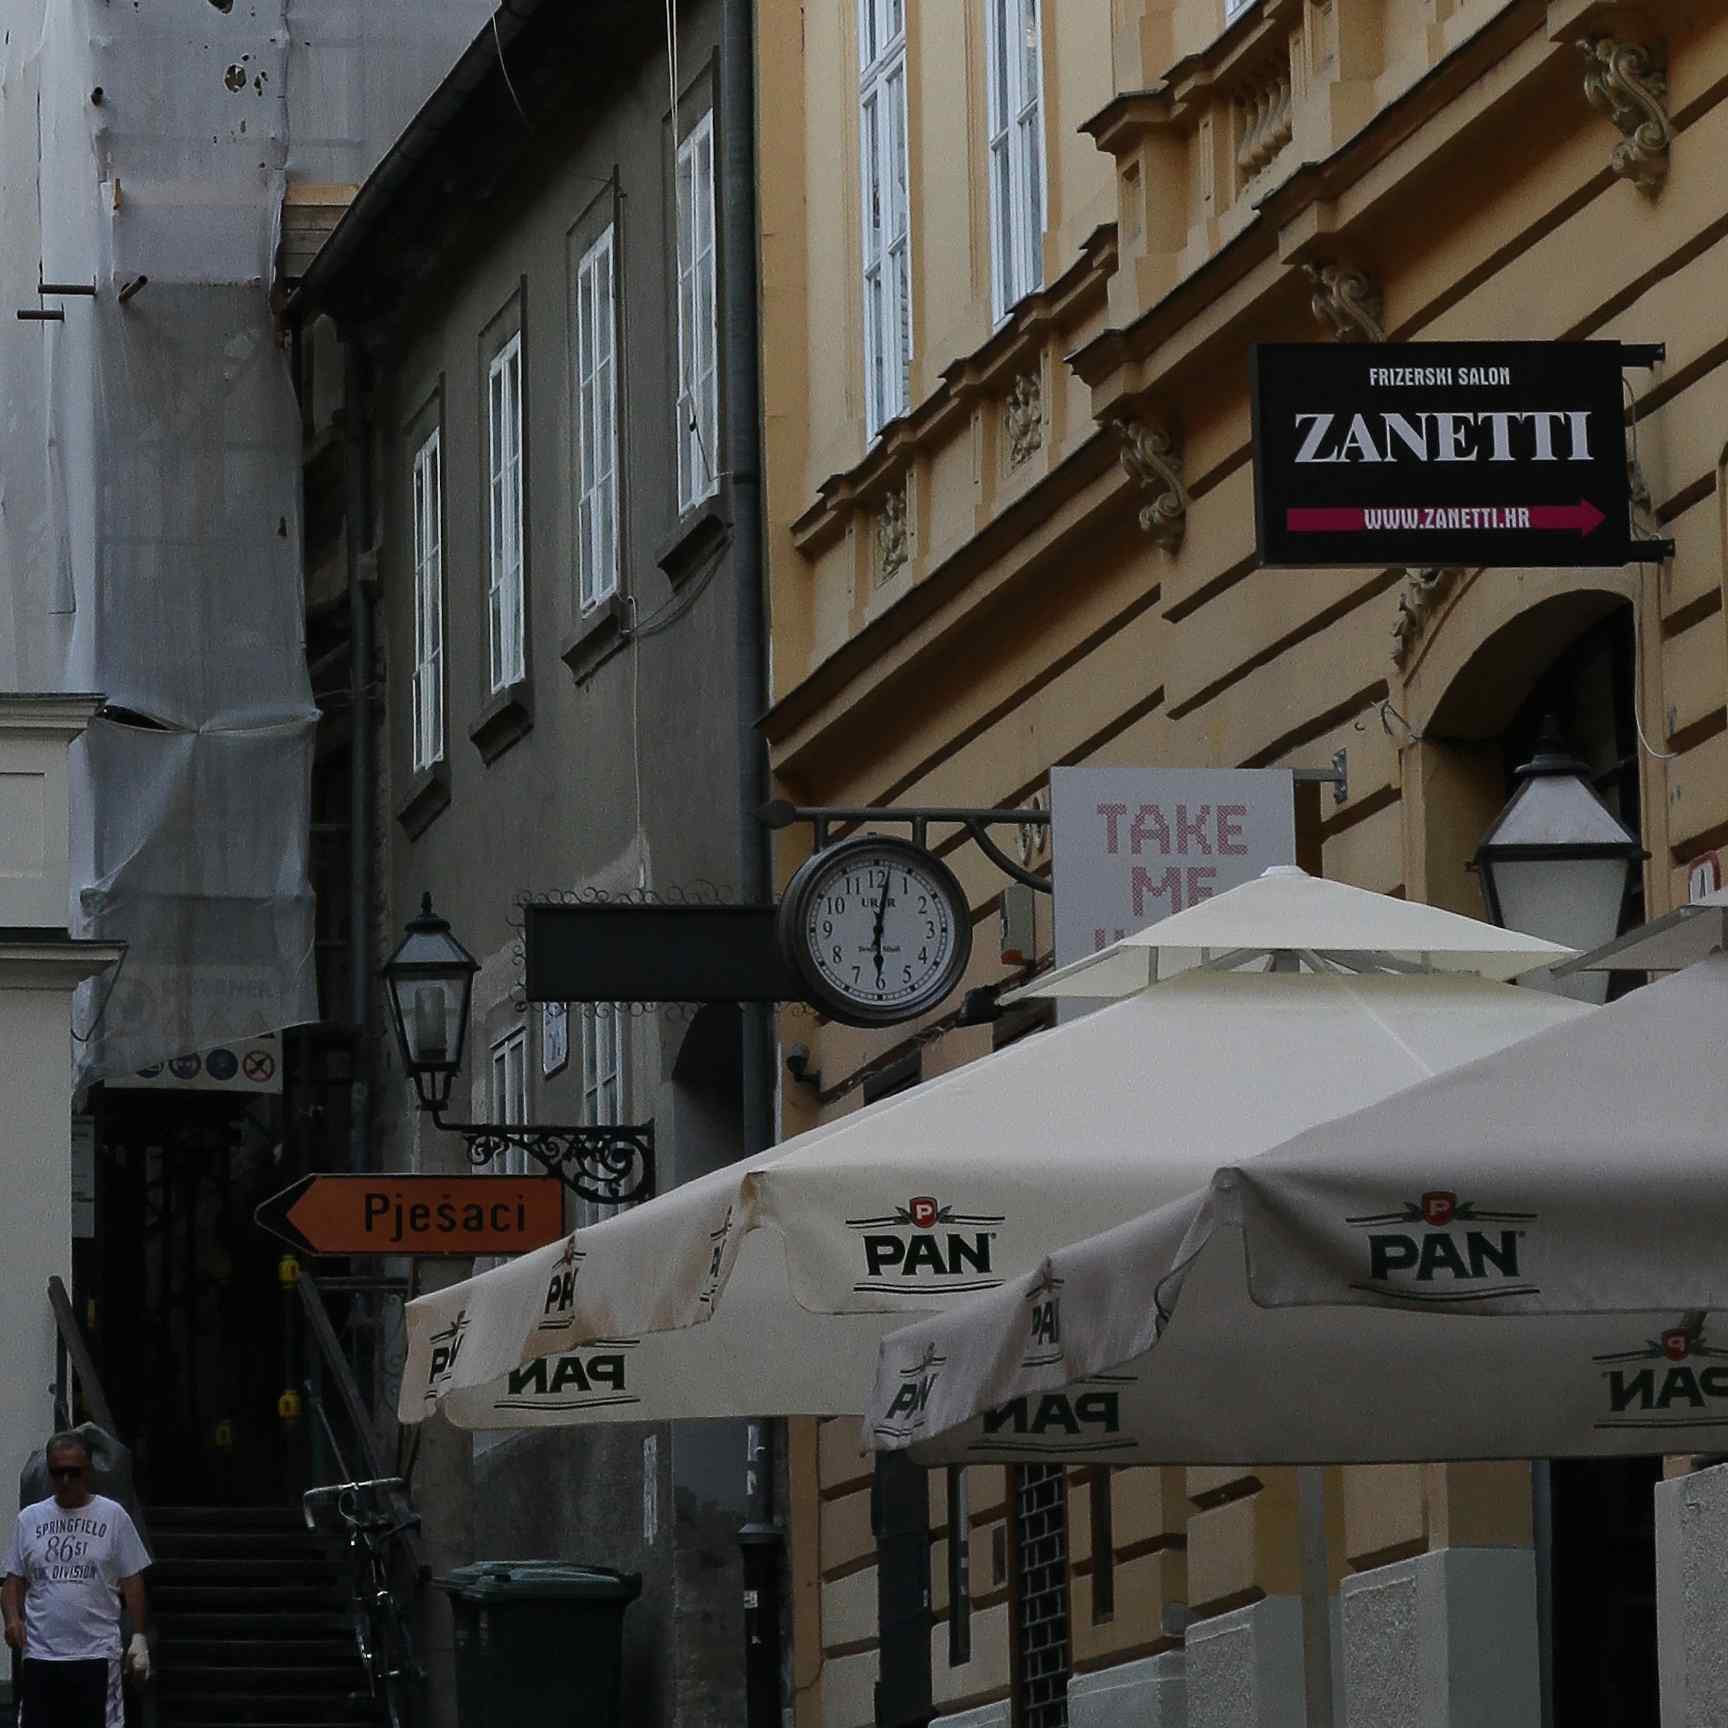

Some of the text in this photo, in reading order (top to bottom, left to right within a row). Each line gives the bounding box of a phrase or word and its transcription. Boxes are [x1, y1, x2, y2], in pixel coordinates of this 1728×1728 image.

[1369, 366, 1511, 387] FRIZERSKI SALON
[1294, 410, 1595, 464] ZANETTI
[1364, 507, 1531, 530] WWW.ZANETTI.HR
[1096, 804, 1249, 855] TAKE
[826, 896, 845, 915] 10
[1132, 866, 1217, 918] ME
[364, 1194, 527, 1242] Pješaci
[863, 1232, 993, 1277] PAN
[1368, 1230, 1521, 1282] PAN
[35, 1518, 108, 1539] SPRINGFIELD
